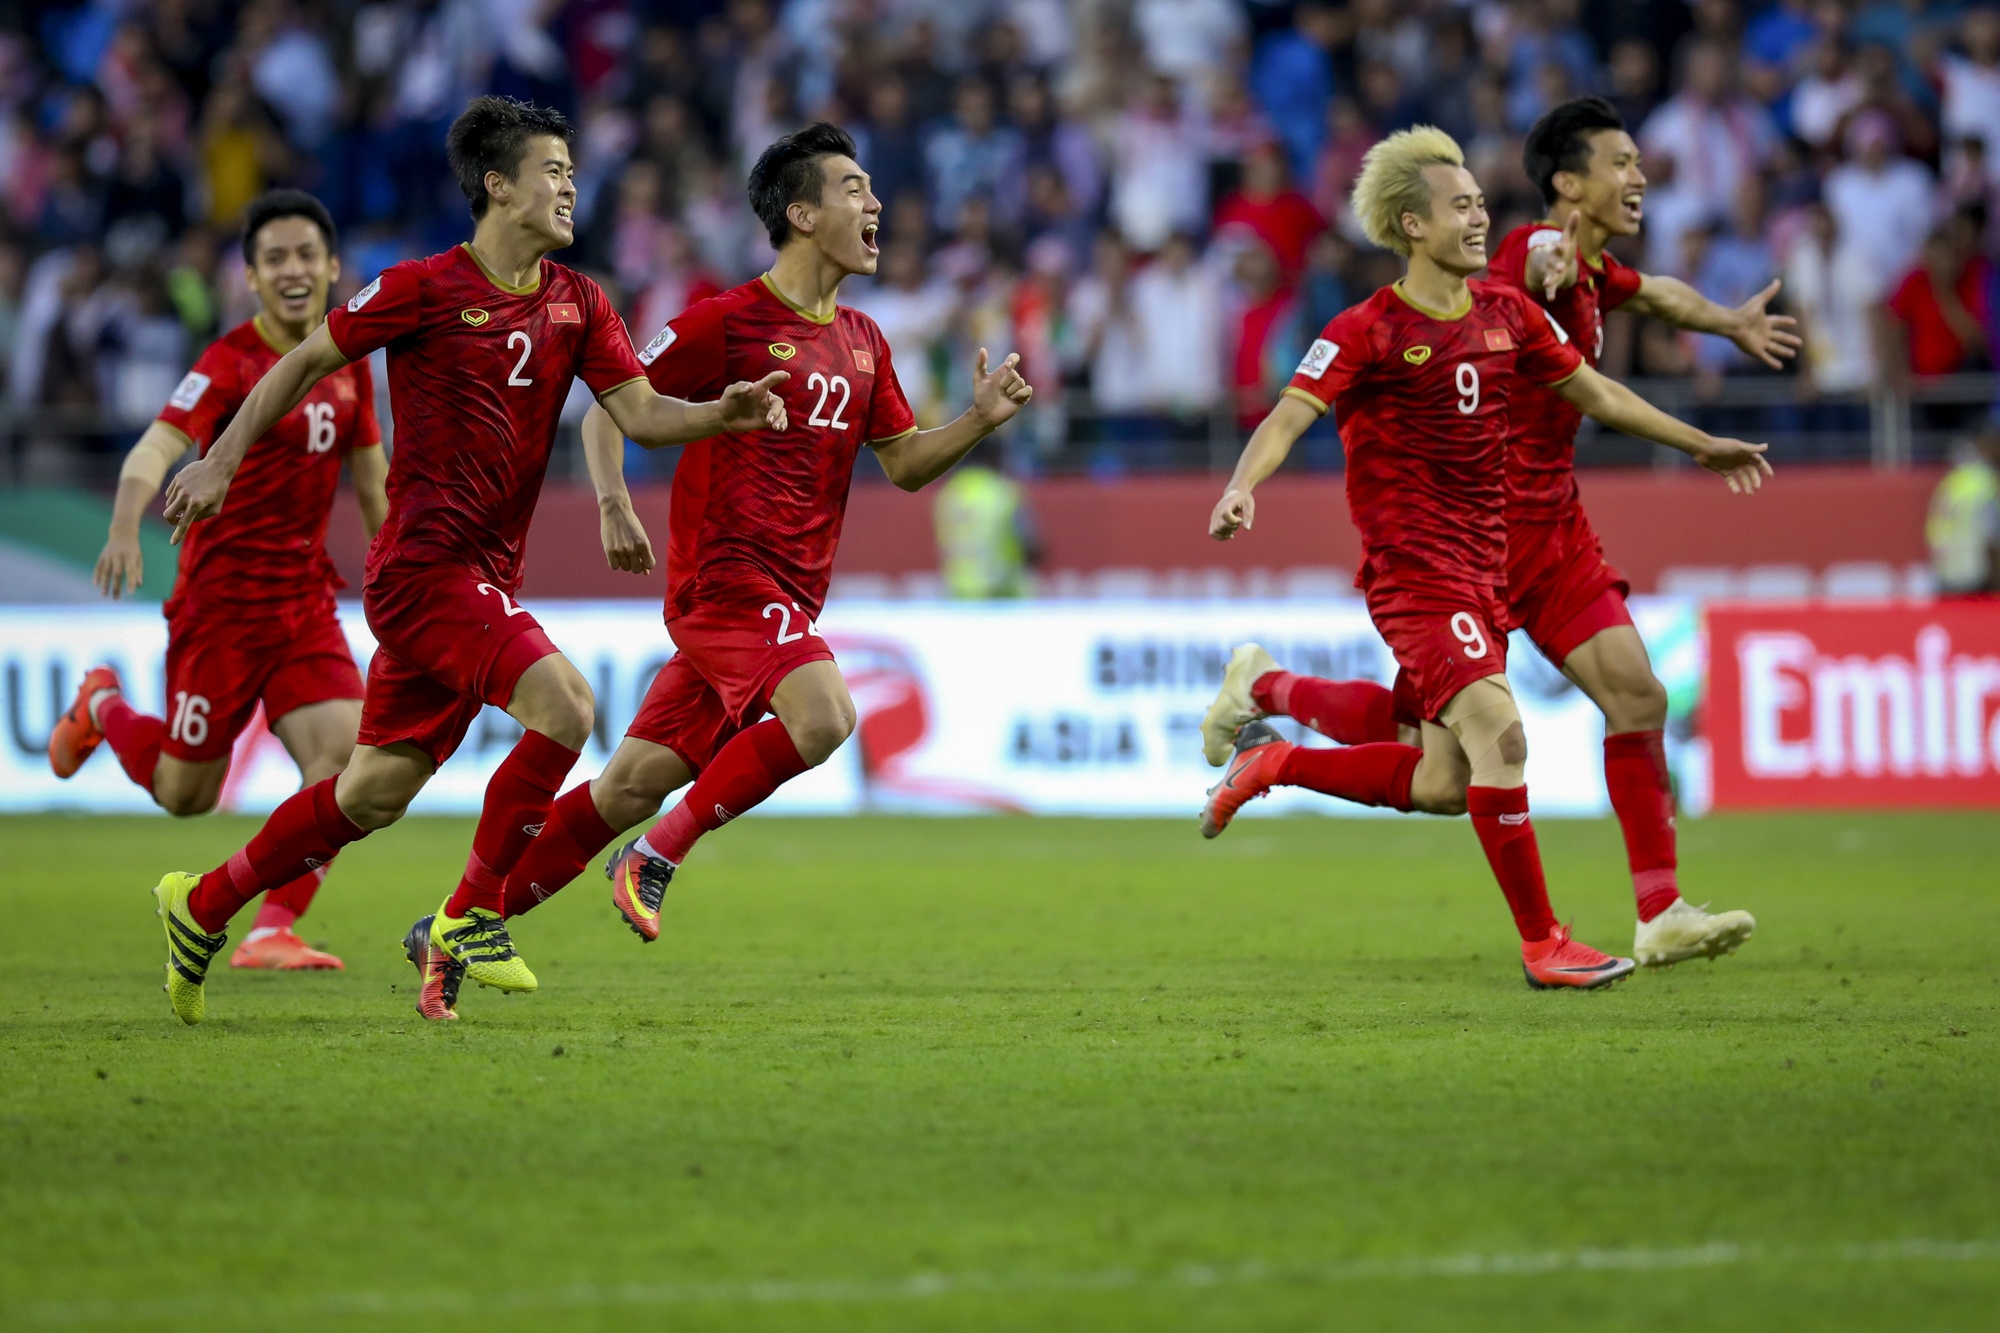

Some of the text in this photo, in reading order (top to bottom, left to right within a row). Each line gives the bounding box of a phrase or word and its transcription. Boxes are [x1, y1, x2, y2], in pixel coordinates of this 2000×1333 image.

[507, 331, 533, 387] 2
[807, 371, 851, 430] 22
[1455, 362, 1480, 415] 9
[304, 402, 336, 452] 16
[476, 582, 526, 617] 2
[1450, 611, 1488, 660] 9
[169, 690, 211, 746] 16
[1738, 625, 2000, 776] Emir
